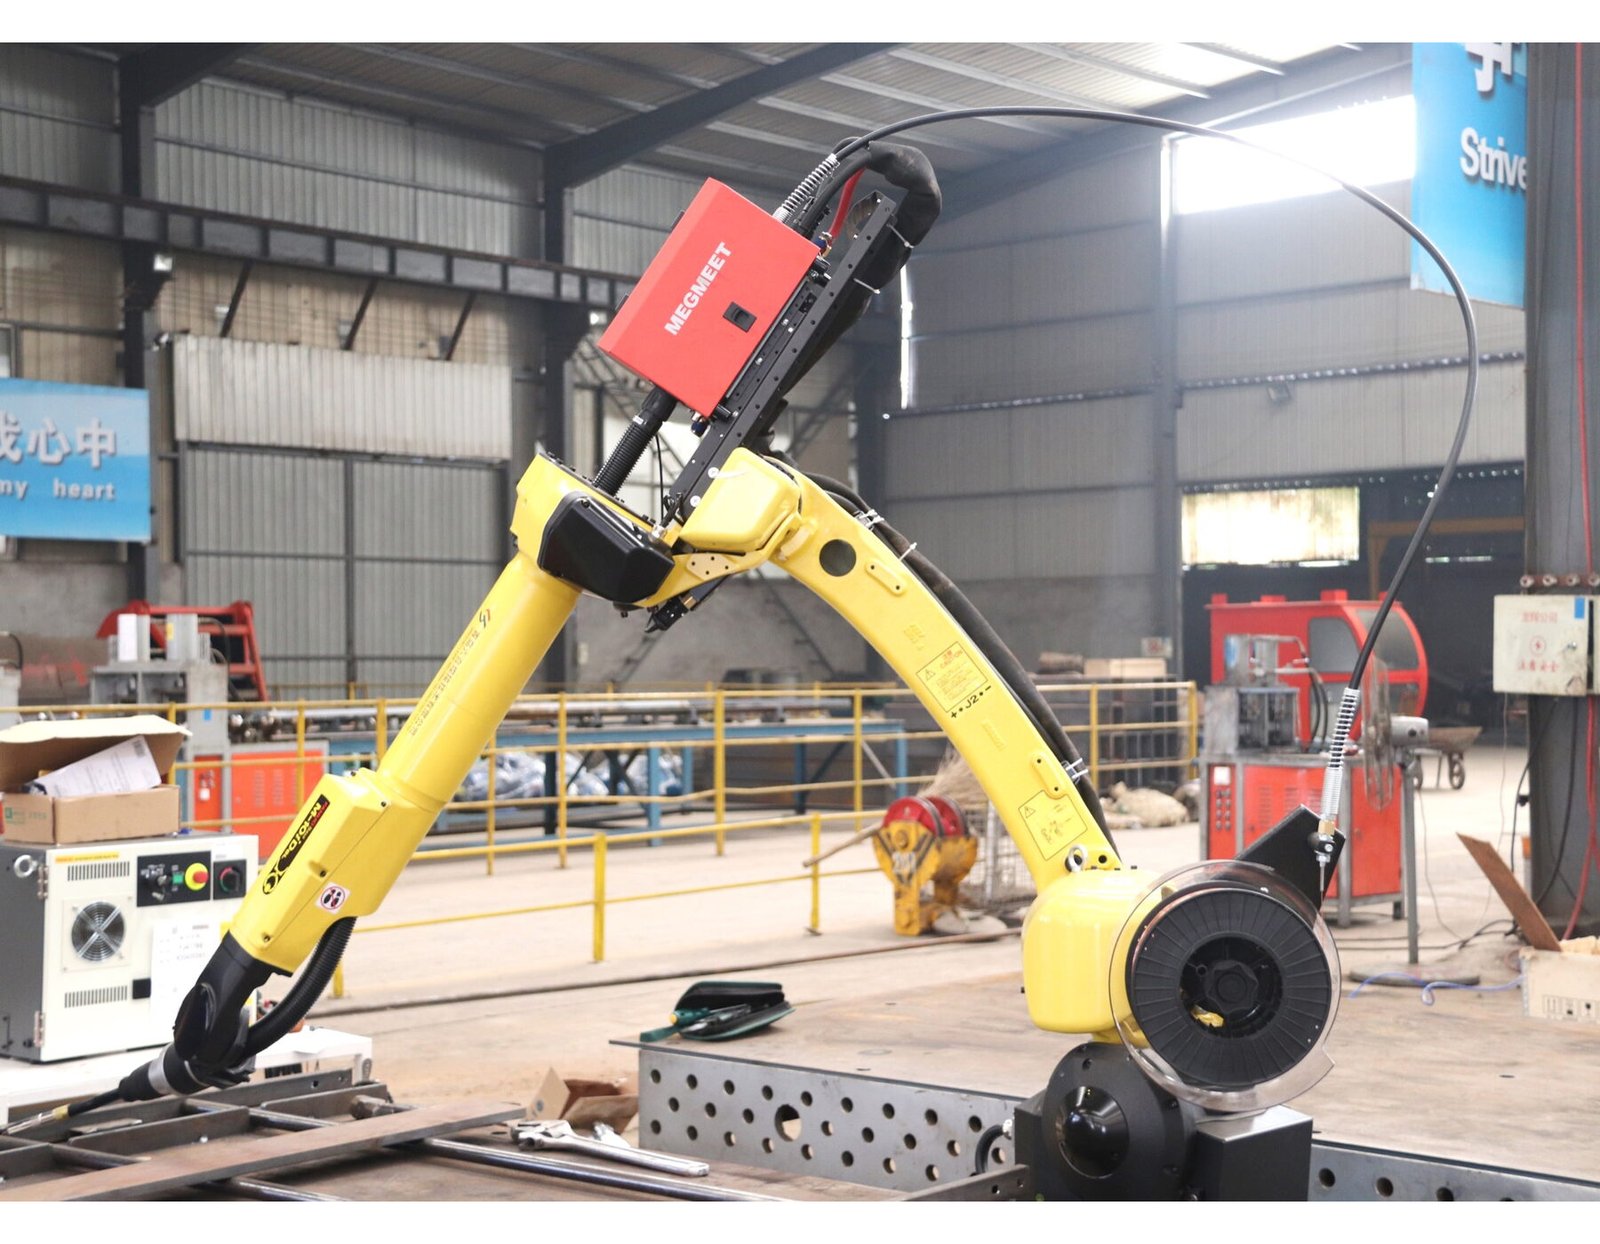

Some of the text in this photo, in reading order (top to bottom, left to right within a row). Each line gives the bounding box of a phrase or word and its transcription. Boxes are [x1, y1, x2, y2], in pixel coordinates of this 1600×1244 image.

[1459, 126, 1526, 190] Strive
[664, 241, 732, 335] MEGMEET
[53, 478, 116, 500] heart
